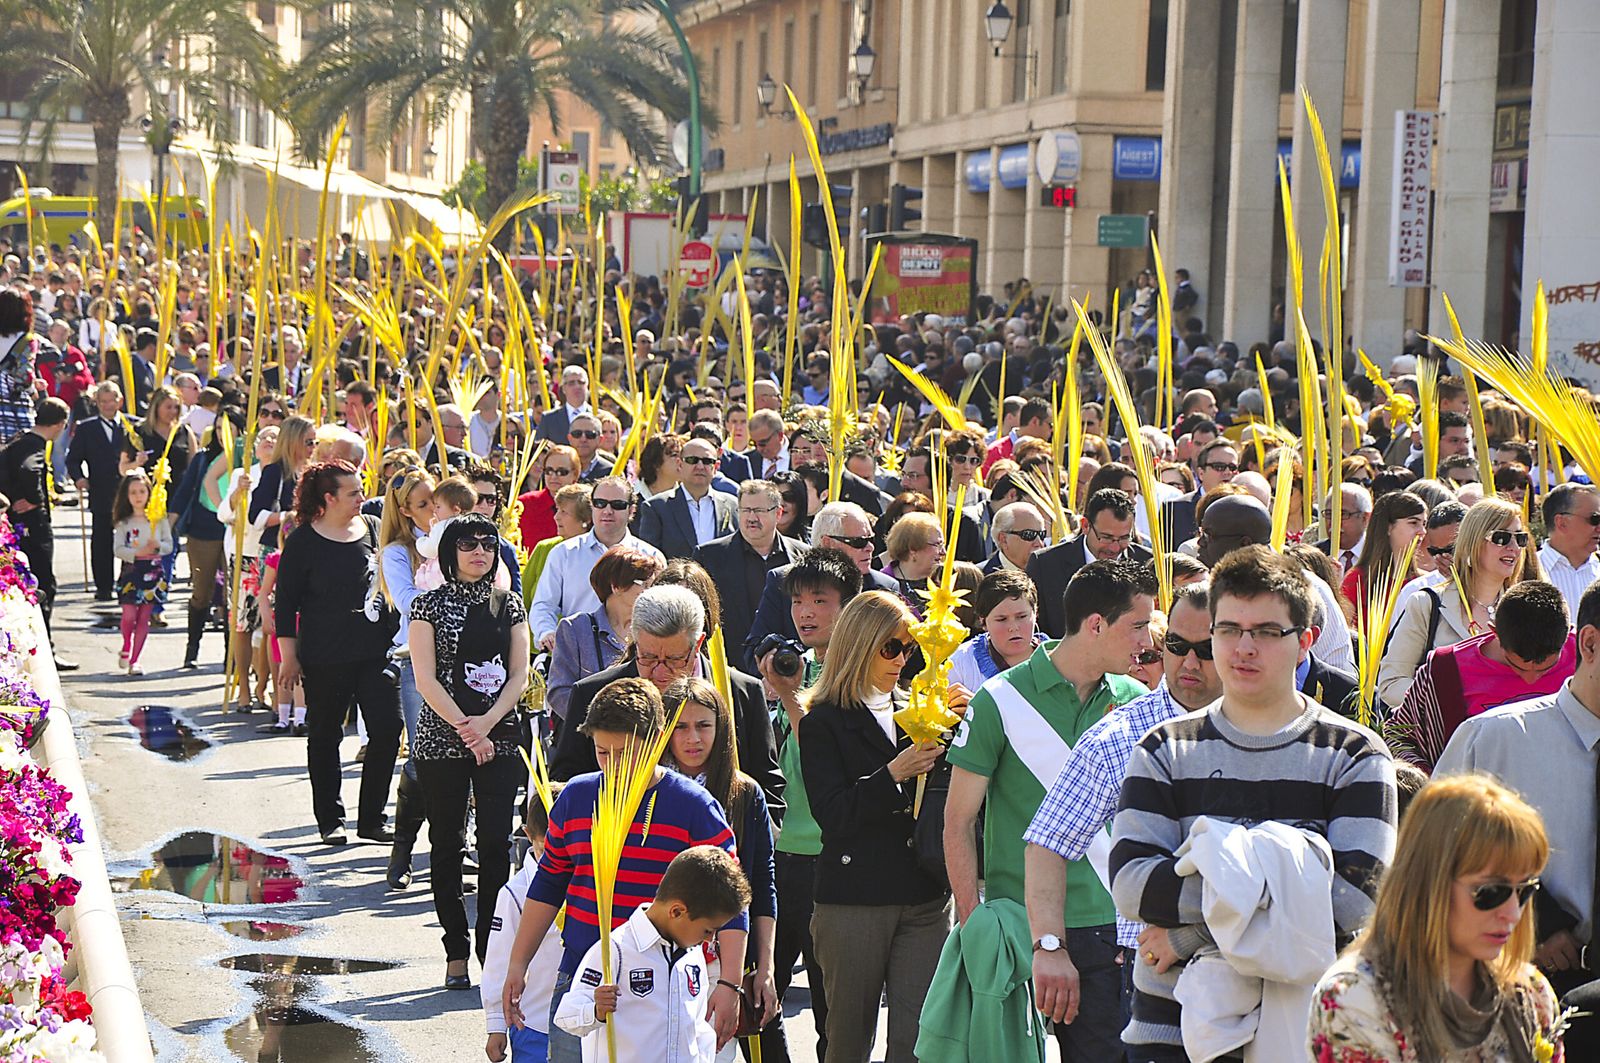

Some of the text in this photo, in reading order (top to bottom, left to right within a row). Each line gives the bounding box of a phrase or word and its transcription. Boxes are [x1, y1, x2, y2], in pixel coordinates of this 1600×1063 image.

[1400, 114, 1416, 264] RESTAURANTE CHINO
[1414, 117, 1429, 260] NUEVA MURALLA
